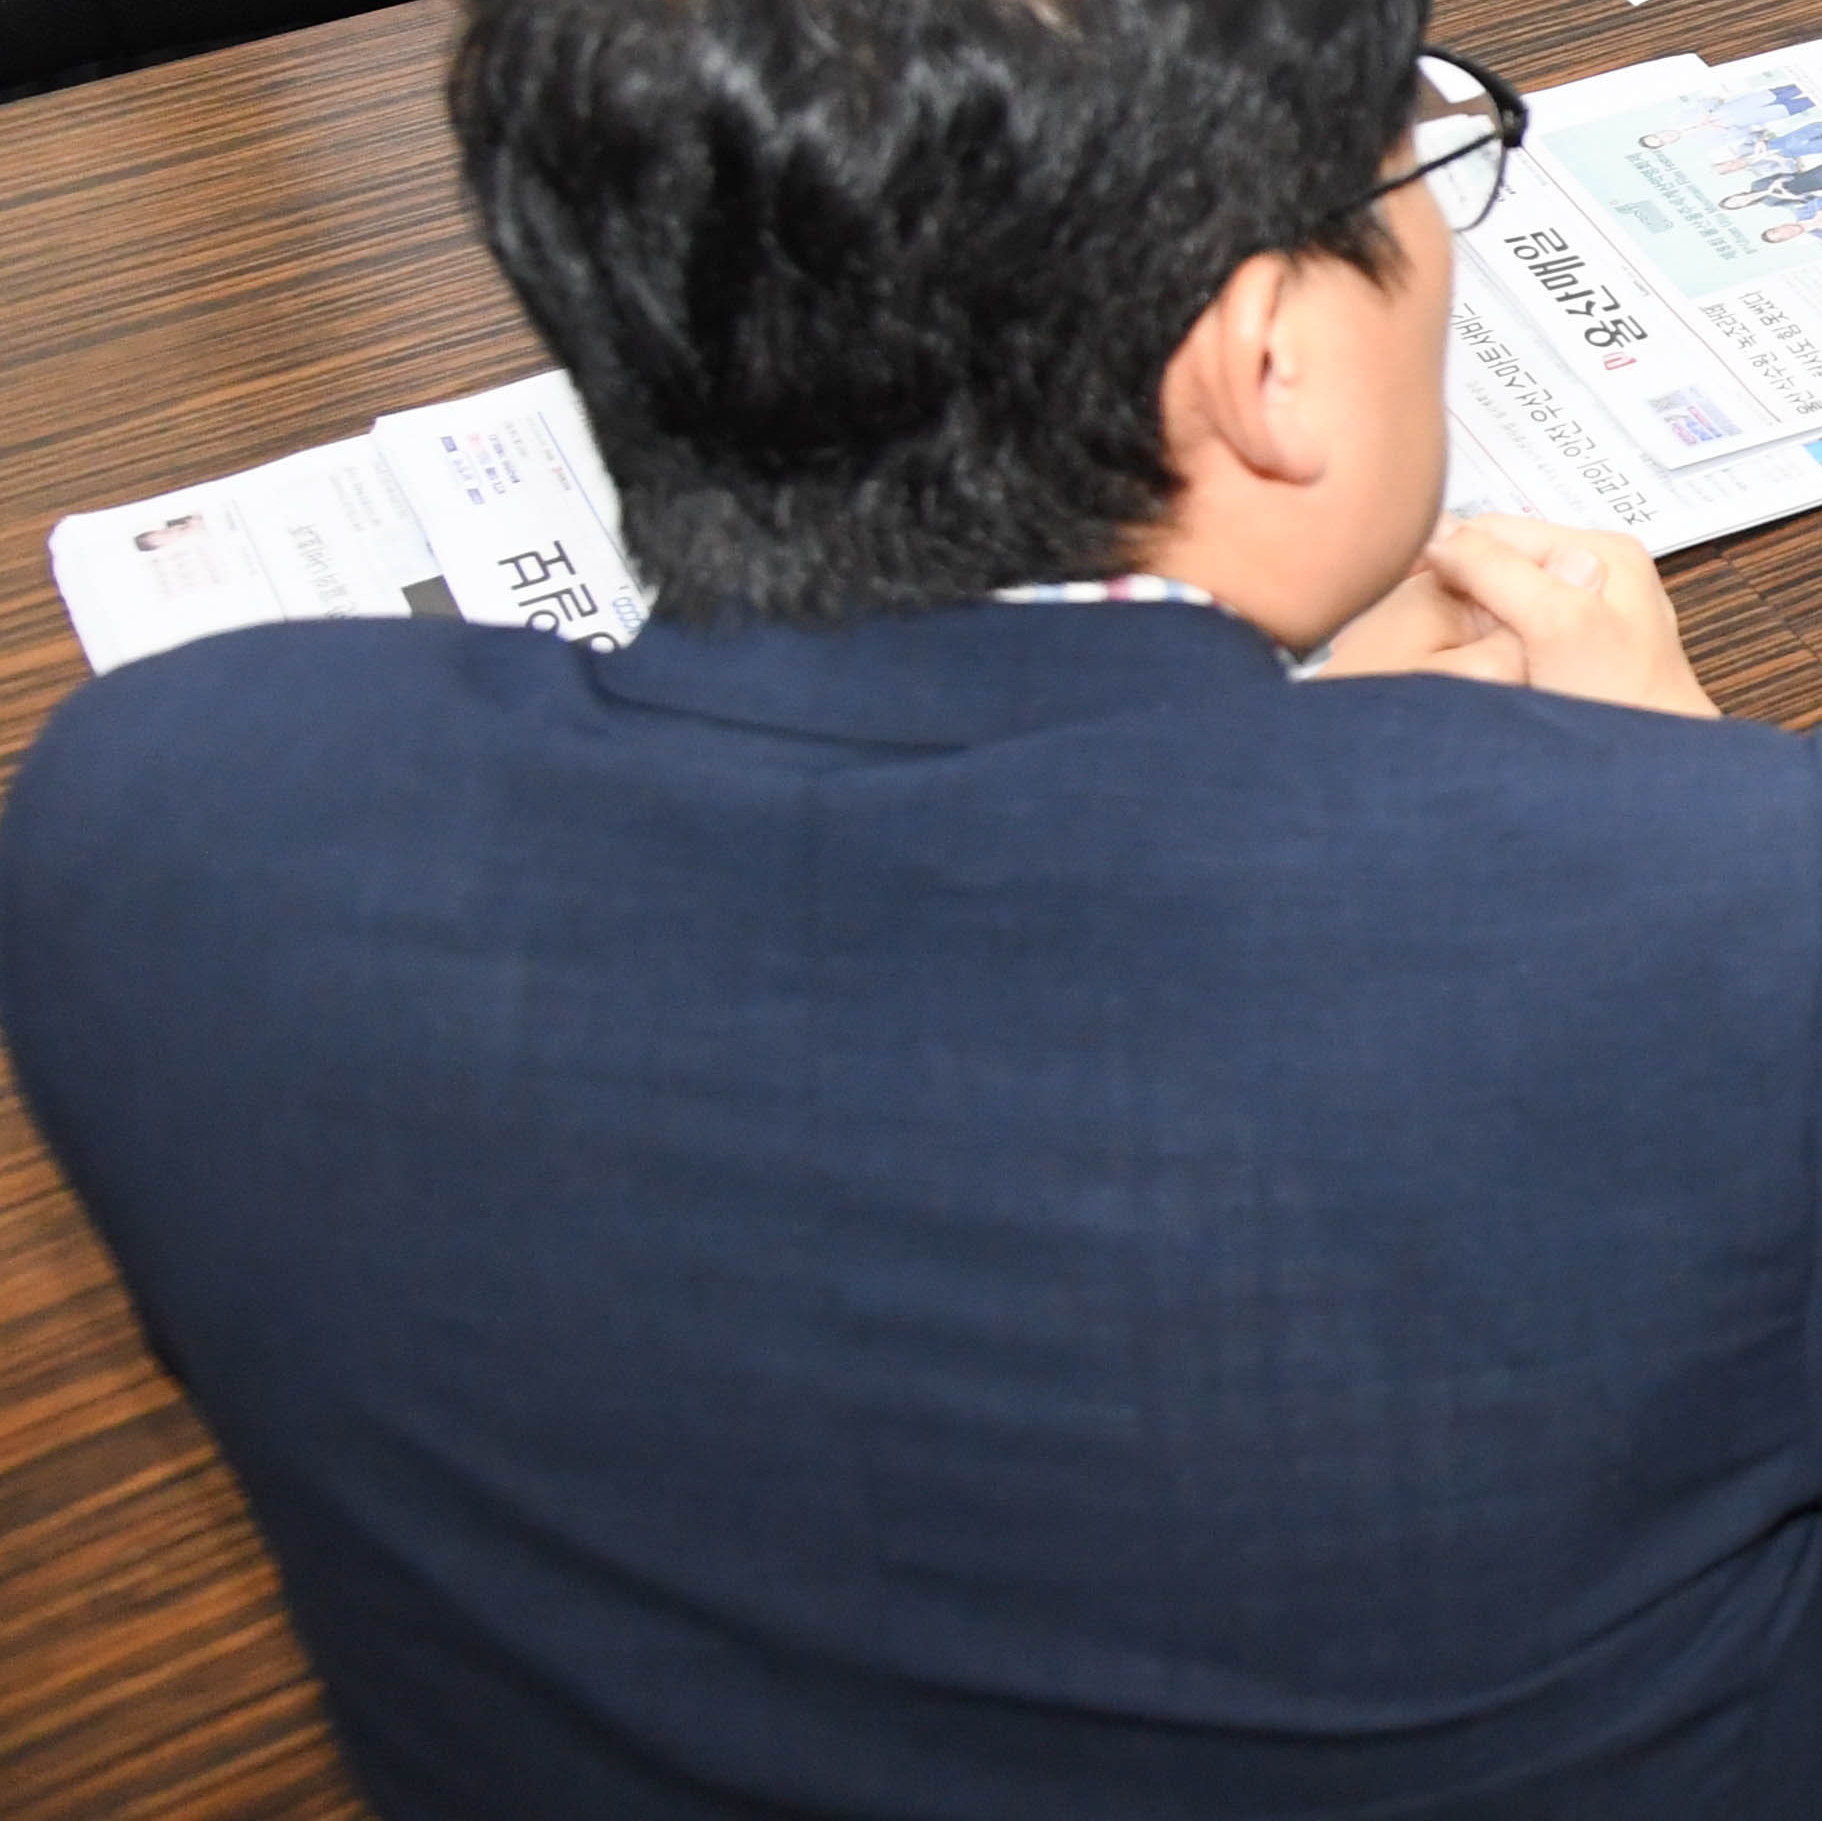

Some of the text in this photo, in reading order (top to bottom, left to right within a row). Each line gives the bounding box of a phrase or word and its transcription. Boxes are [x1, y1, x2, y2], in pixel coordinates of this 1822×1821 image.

[1502, 216, 1651, 358] 울산매일
[1512, 385, 1566, 426] 우선
[1608, 490, 1660, 528] 주민
[497, 538, 625, 655] 일보
